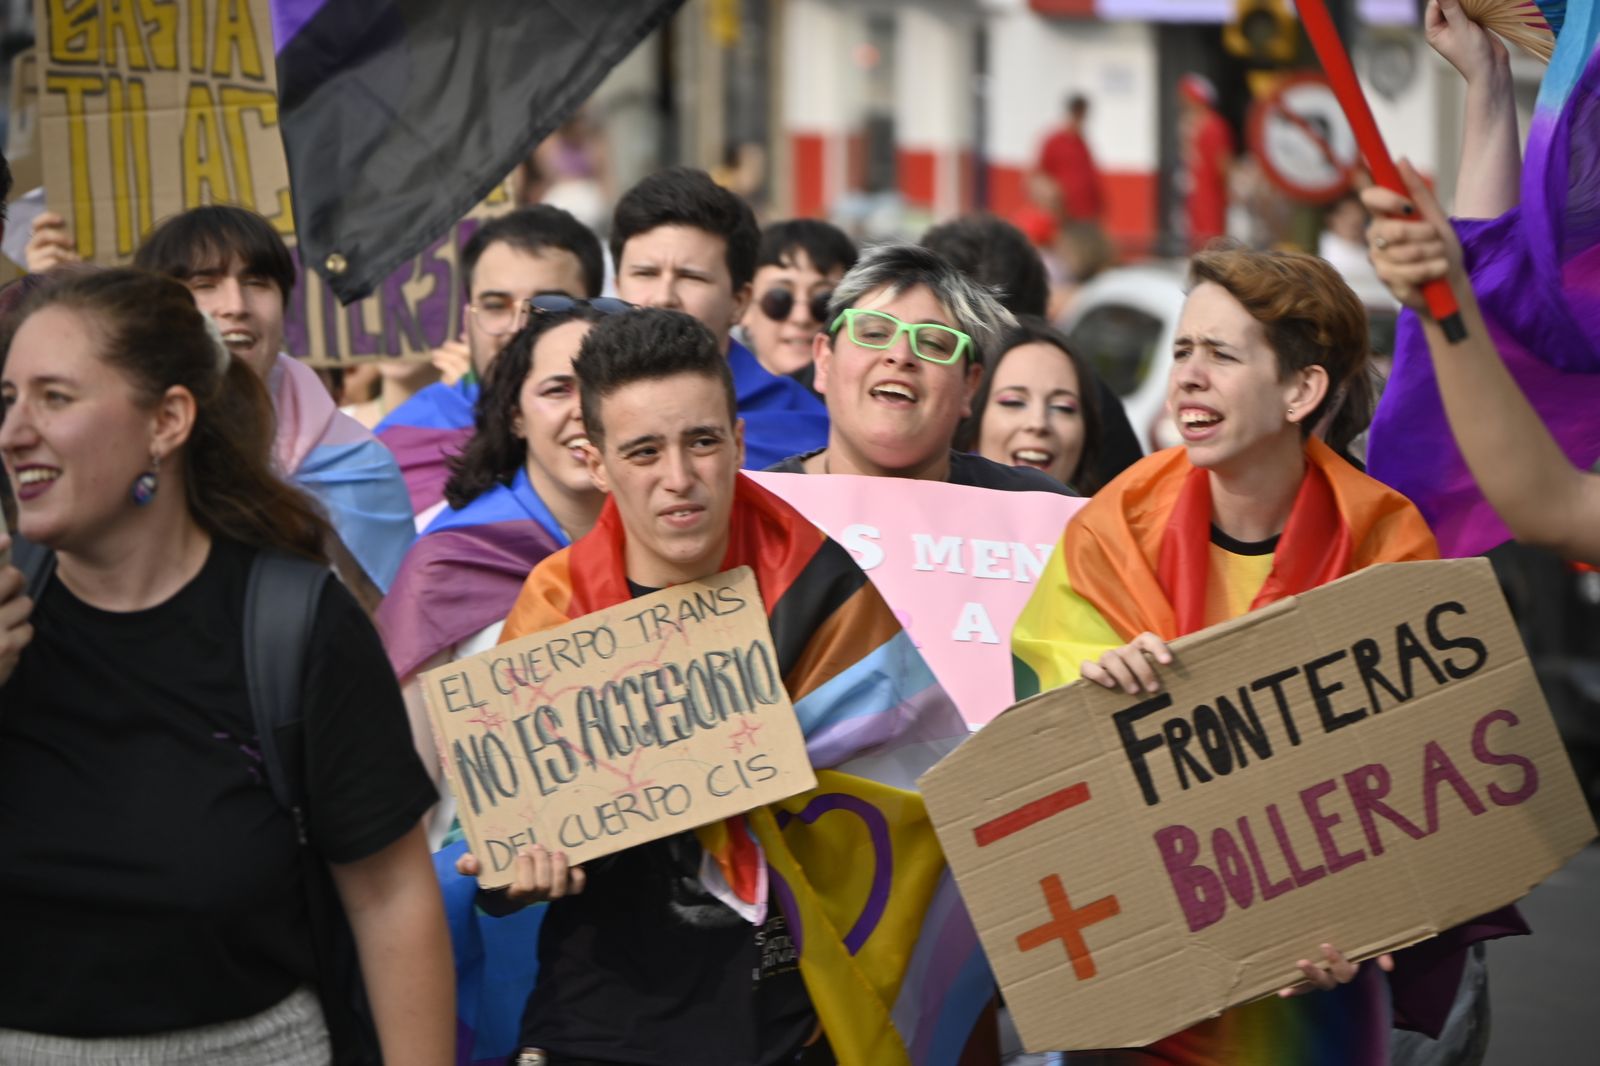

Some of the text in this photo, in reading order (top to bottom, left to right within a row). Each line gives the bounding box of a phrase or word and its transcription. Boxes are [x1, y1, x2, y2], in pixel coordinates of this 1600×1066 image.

[439, 586, 747, 713] EL CUERPO TRANS
[452, 639, 781, 816] NO ES ACCESORIO
[1111, 601, 1488, 806] FRONTERAS
[558, 783, 692, 848] CUERPO
[705, 753, 778, 797] CIS
[1152, 709, 1539, 933] BOLLERAS
